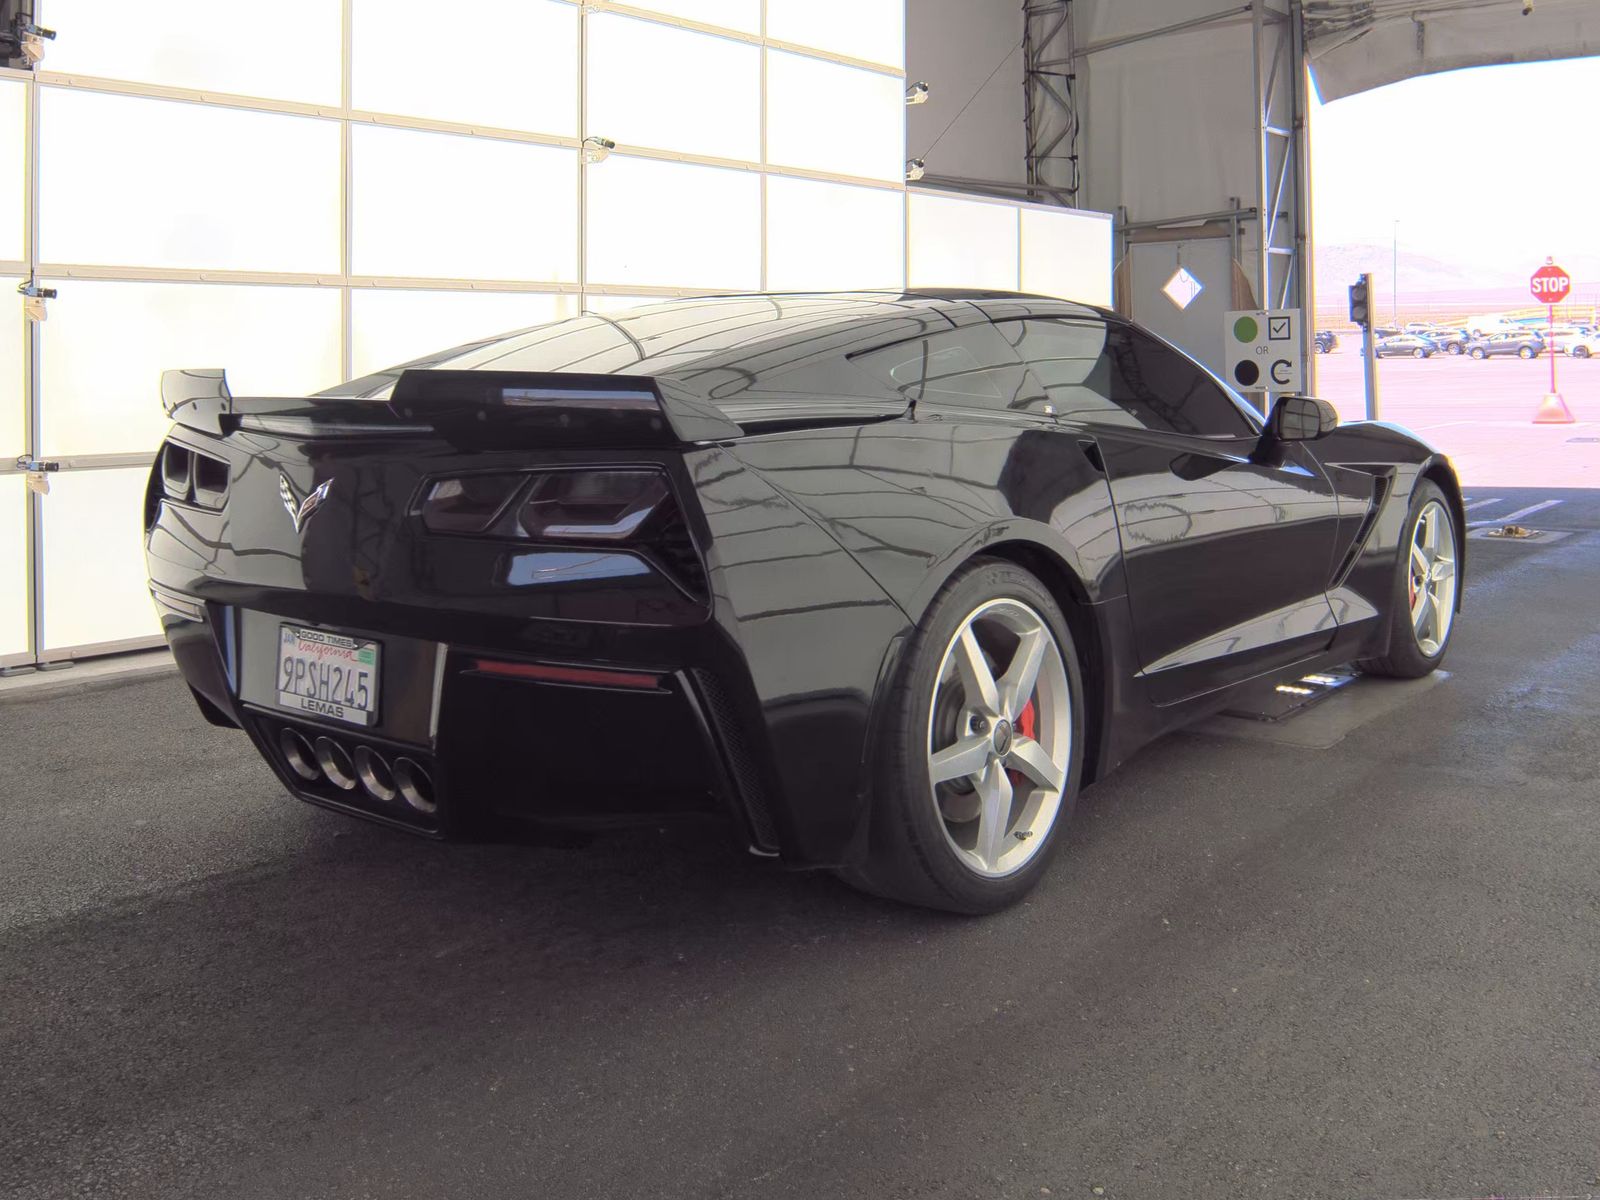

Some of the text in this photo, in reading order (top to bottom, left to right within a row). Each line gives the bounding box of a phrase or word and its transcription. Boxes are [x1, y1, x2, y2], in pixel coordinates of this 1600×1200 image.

[1532, 276, 1569, 293] STOP
[1255, 346, 1269, 355] OR
[301, 631, 353, 648] GOOD TIMES
[283, 656, 368, 710] 9PSH245
[300, 698, 344, 718] LEMAS
